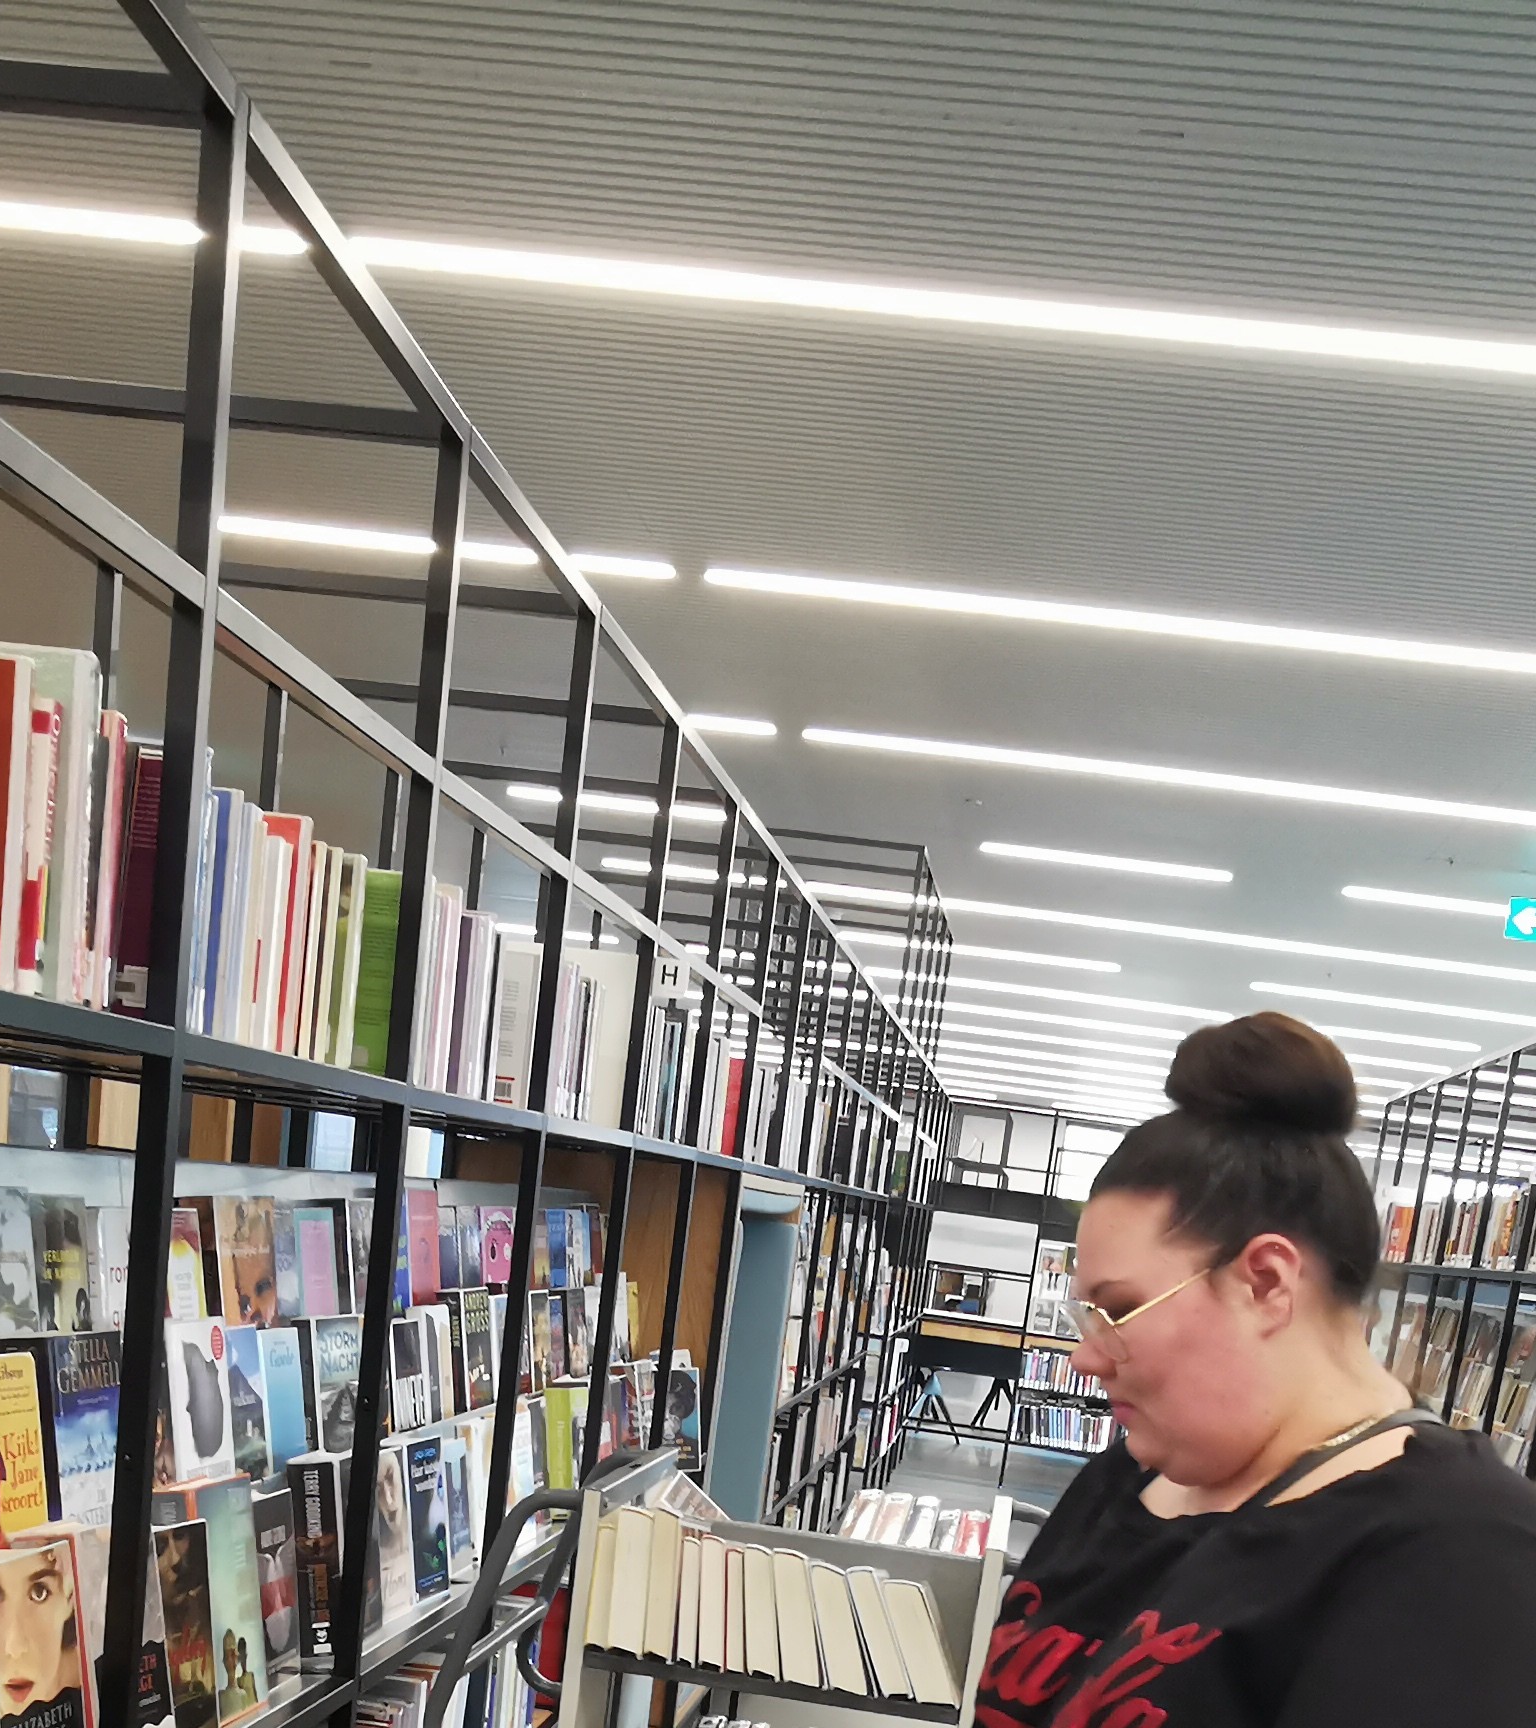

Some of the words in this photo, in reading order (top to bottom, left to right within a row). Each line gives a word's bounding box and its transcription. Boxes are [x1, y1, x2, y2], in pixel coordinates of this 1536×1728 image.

[662, 964, 678, 986] H
[69, 1337, 111, 1364] STELLA
[2, 1429, 40, 1462] Kijk!
[9, 1461, 39, 1490] Jane
[1, 1482, 44, 1514] scoort!
